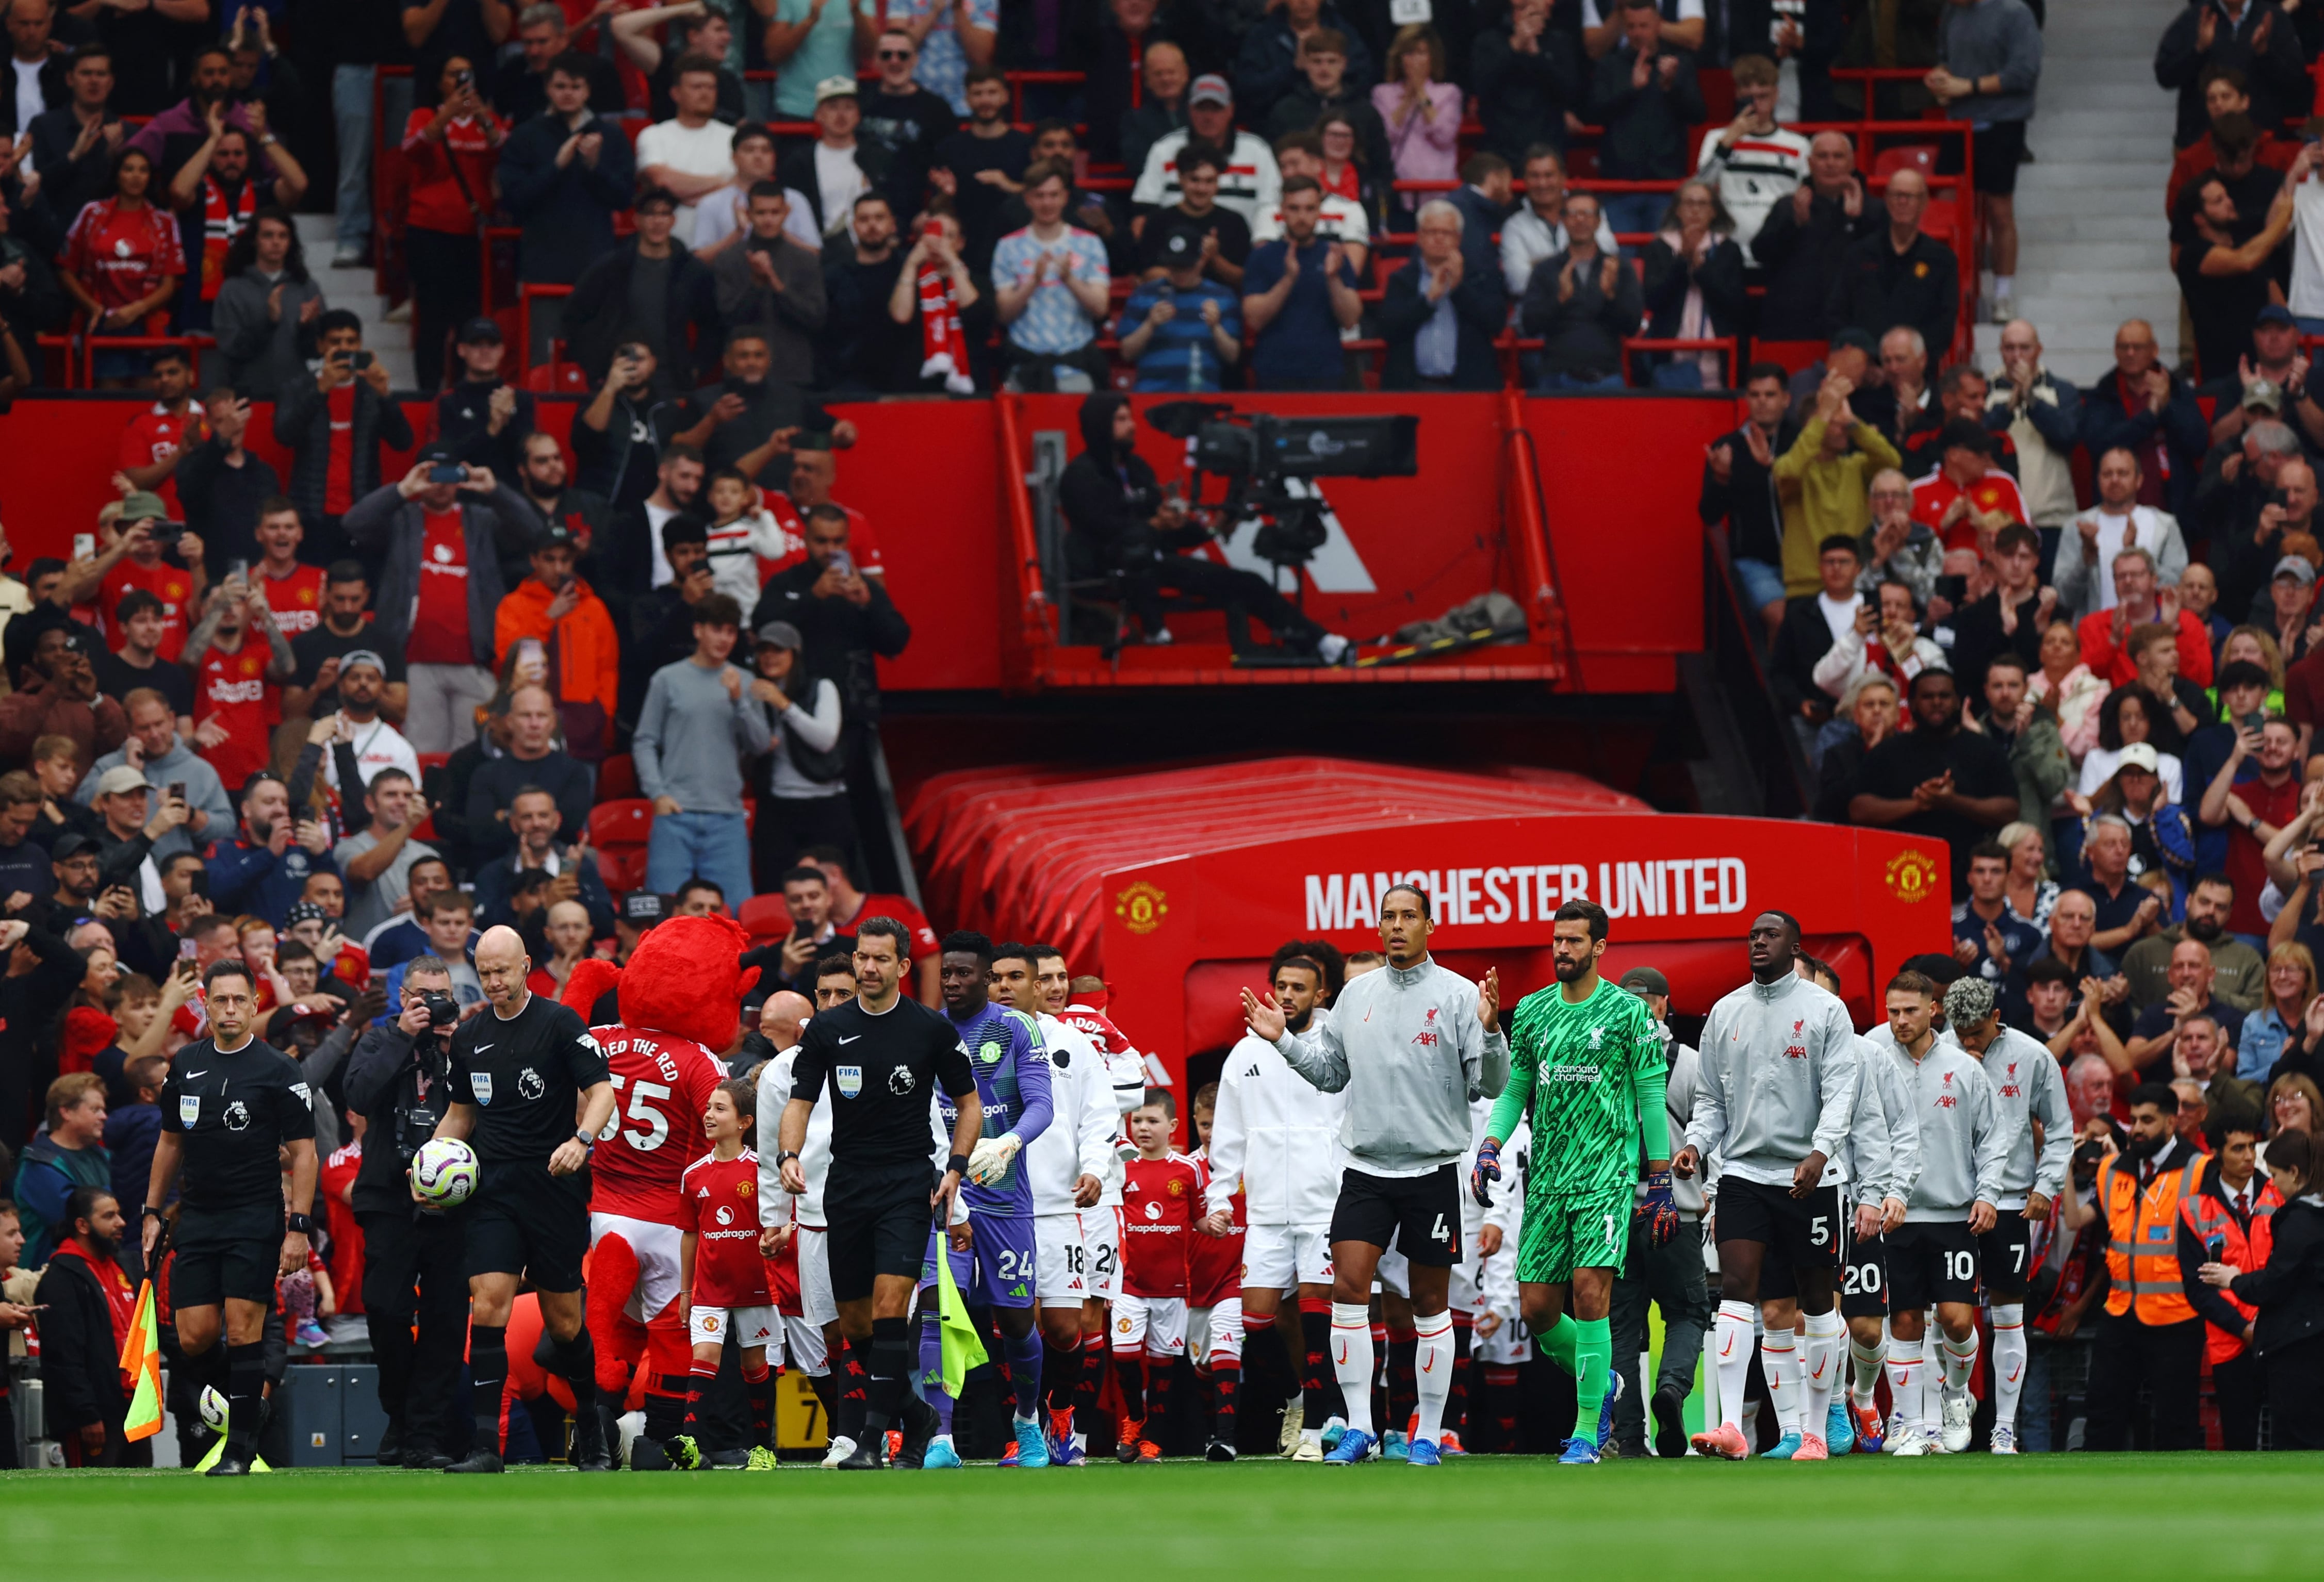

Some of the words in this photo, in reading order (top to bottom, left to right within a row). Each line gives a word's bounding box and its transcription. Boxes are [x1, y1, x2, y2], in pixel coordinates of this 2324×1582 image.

[1599, 856, 1747, 919] UNITED
[1065, 1017, 1105, 1033] ADDY
[1411, 1032, 1437, 1047] AXA
[1635, 1030, 1660, 1046] Expe
[602, 1040, 628, 1058] RED
[632, 1038, 659, 1057] THE
[655, 1051, 679, 1082] RED
[1781, 1045, 1807, 1059] AXA
[839, 1068, 859, 1077] FIFA
[1553, 1064, 1599, 1074] standard
[1554, 1072, 1602, 1082] chartered
[182, 1098, 197, 1107] FIFA
[1933, 1095, 1956, 1109] AXA
[1998, 1085, 2021, 1097] AXA
[702, 1228, 757, 1241] Snapdragon
[1127, 1223, 1182, 1234] Snapdragon
[1431, 1213, 1449, 1243] 4
[1604, 1215, 1613, 1244] 1
[1810, 1215, 1829, 1245] 5
[998, 1250, 1033, 1281] 24
[1065, 1245, 1084, 1274] 18
[1095, 1244, 1118, 1276] 20
[1944, 1250, 1974, 1280] 10
[2010, 1244, 2025, 1273] 7
[1844, 1263, 1881, 1295] 20
[1509, 1317, 1529, 1342] 10
[801, 1399, 819, 1441] 7
